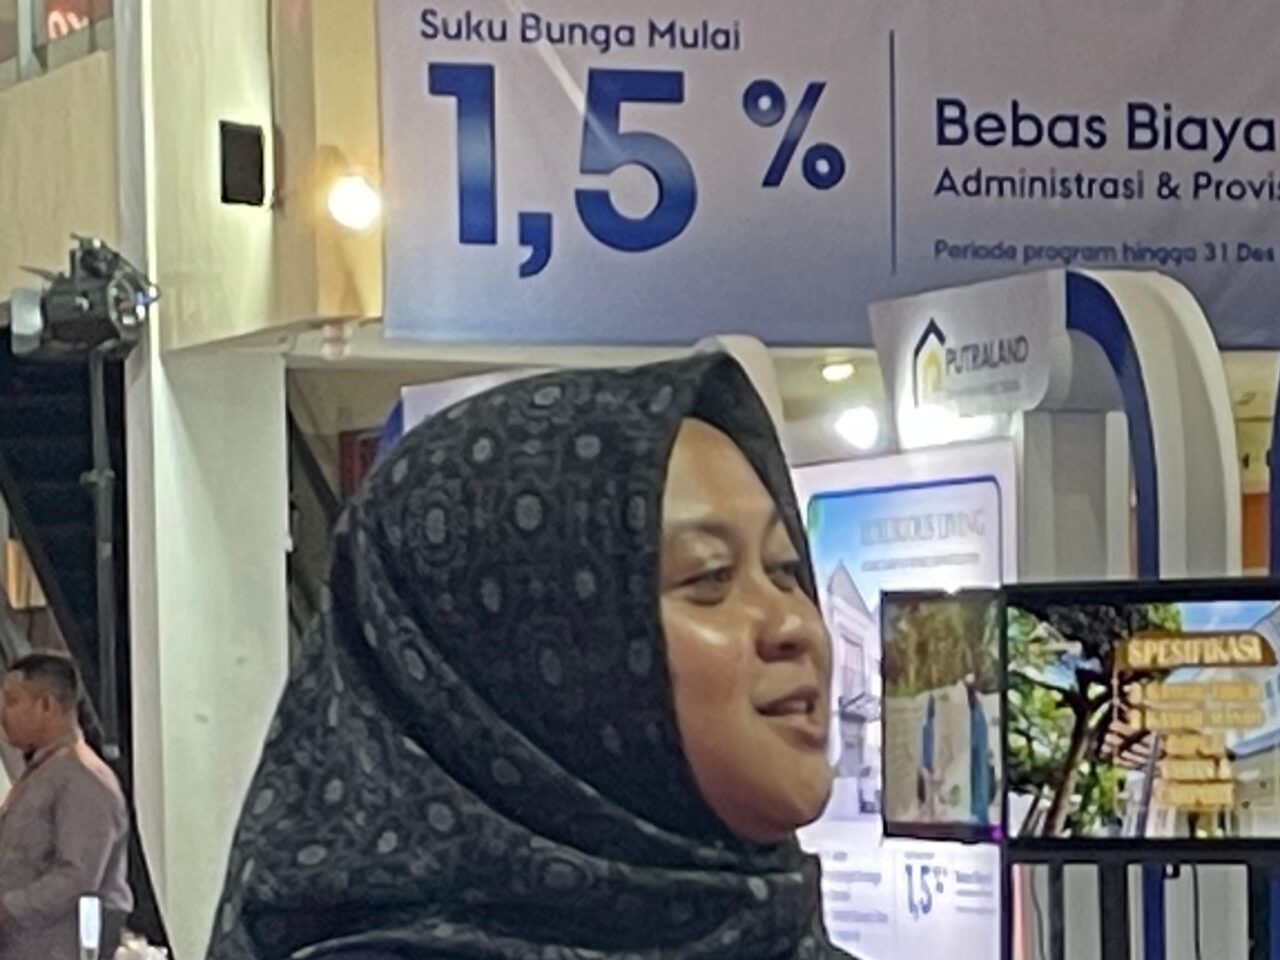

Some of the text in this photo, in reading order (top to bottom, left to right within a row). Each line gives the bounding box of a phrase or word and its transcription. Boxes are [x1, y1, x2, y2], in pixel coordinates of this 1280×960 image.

[420, 8, 741, 53] Suku Bunga Mulai
[935, 97, 1277, 162] Bebas Biaya
[428, 62, 846, 278] 1,5 %
[934, 166, 1144, 200] Administrasi
[1157, 172, 1180, 200] &
[933, 239, 1017, 260] Periode
[1023, 243, 1117, 266] program
[1122, 241, 1196, 266] hingga
[1204, 242, 1228, 262] 31
[1237, 242, 1274, 262] Des
[945, 335, 1029, 375] PUTRALAND
[1128, 633, 1263, 667] SPESIFIKASI
